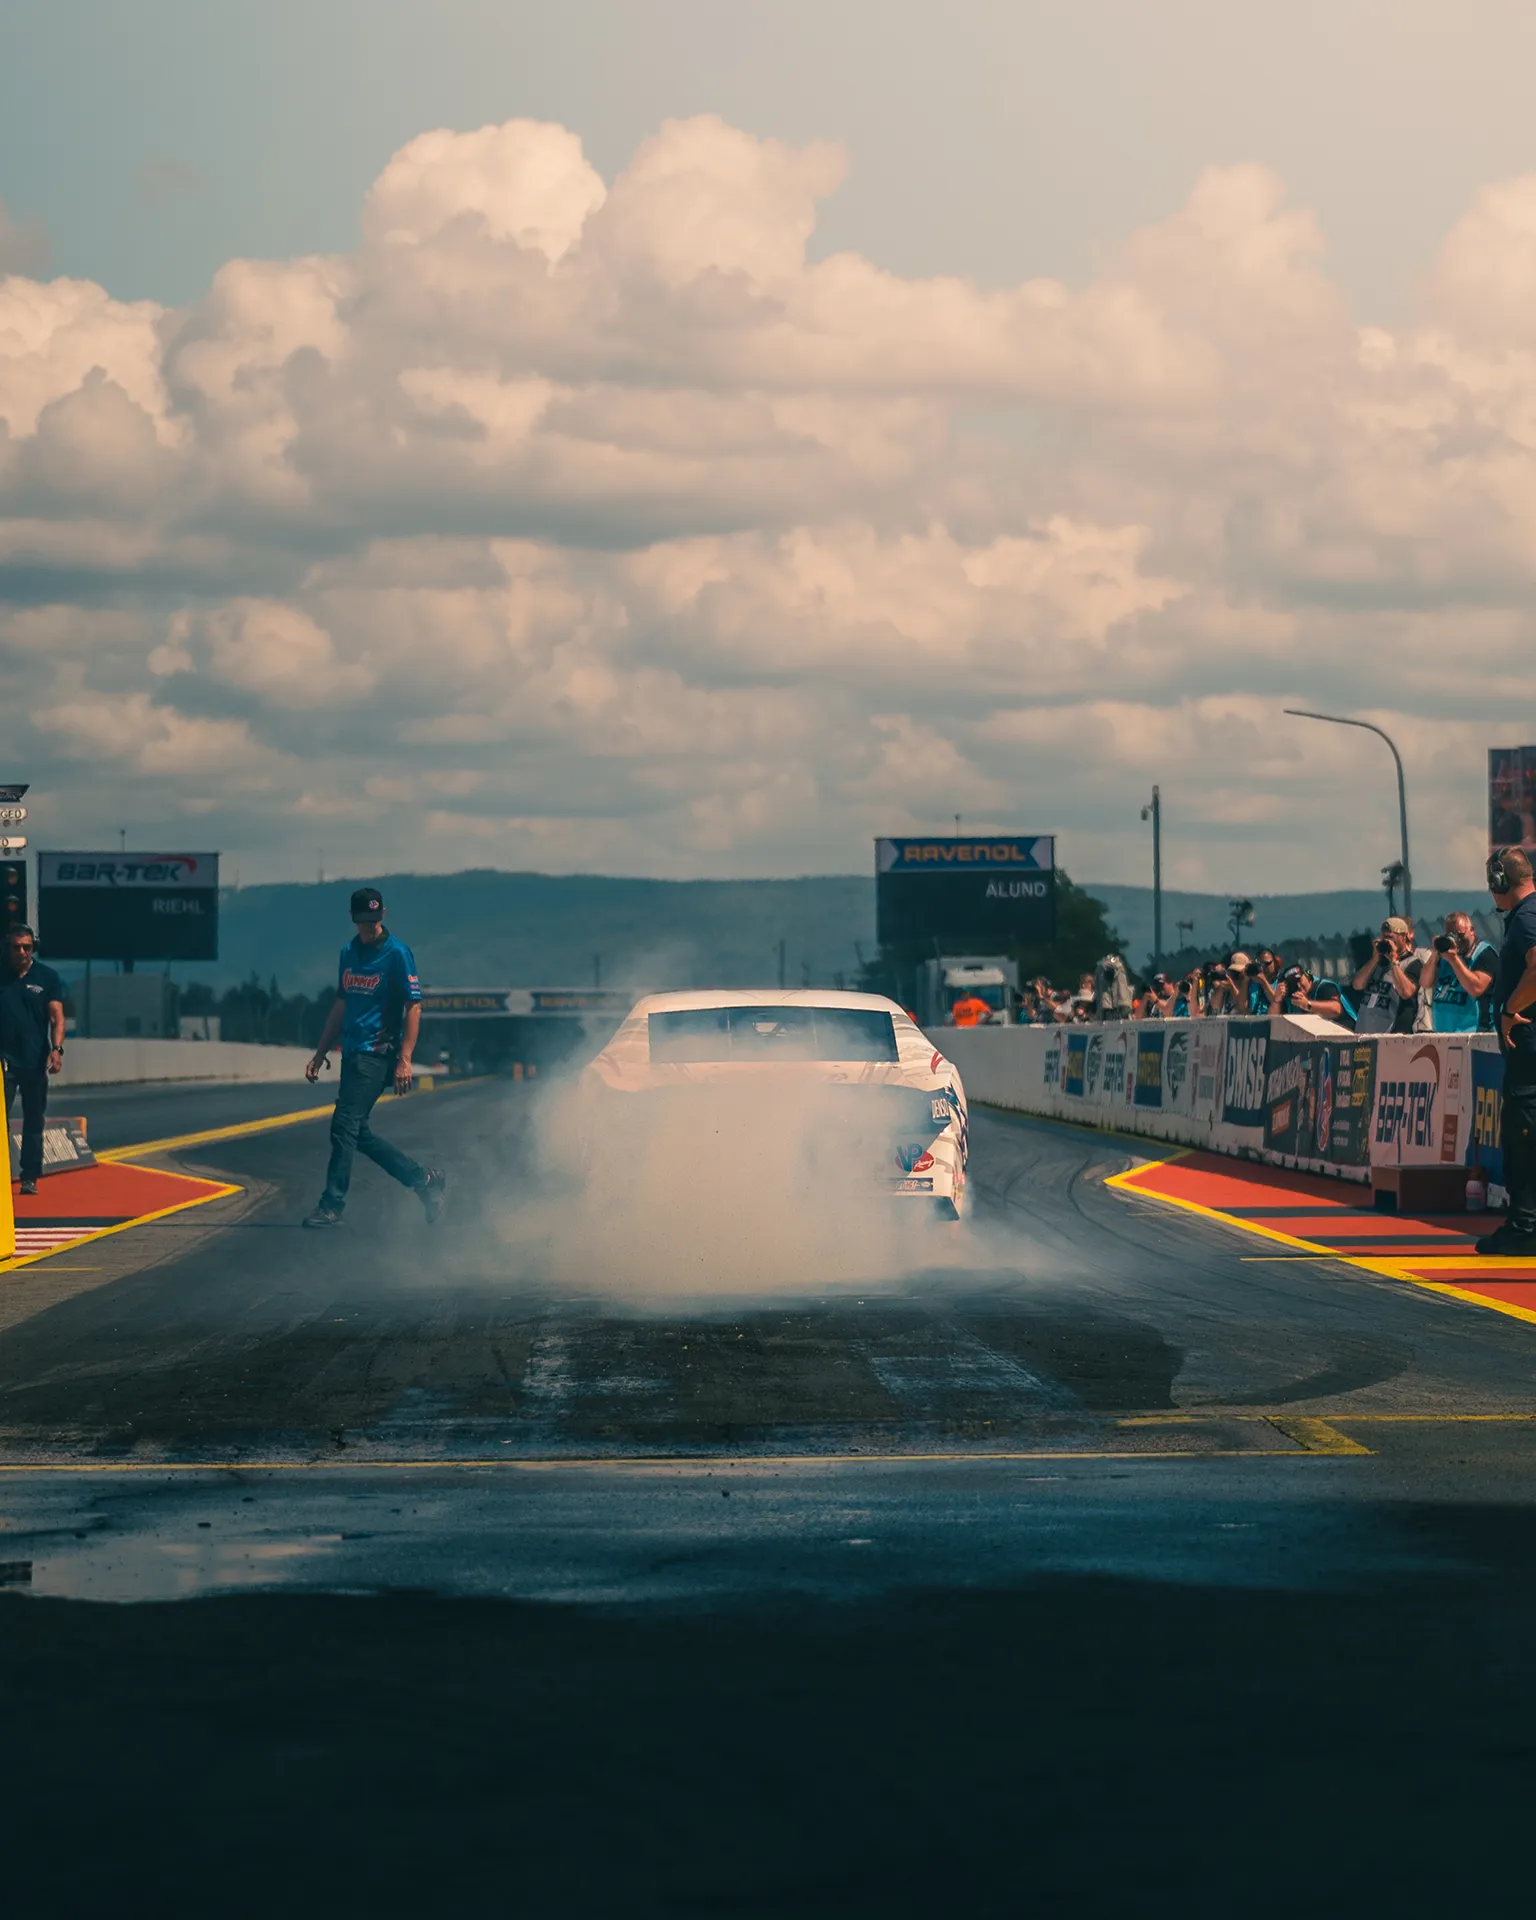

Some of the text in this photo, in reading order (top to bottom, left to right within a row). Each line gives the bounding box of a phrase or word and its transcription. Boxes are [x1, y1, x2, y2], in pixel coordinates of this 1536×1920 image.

[903, 844, 1026, 862] RAVENOL
[152, 898, 205, 915] RIEHL
[1225, 1036, 1267, 1110] DMSB
[931, 1098, 950, 1119] DENSO
